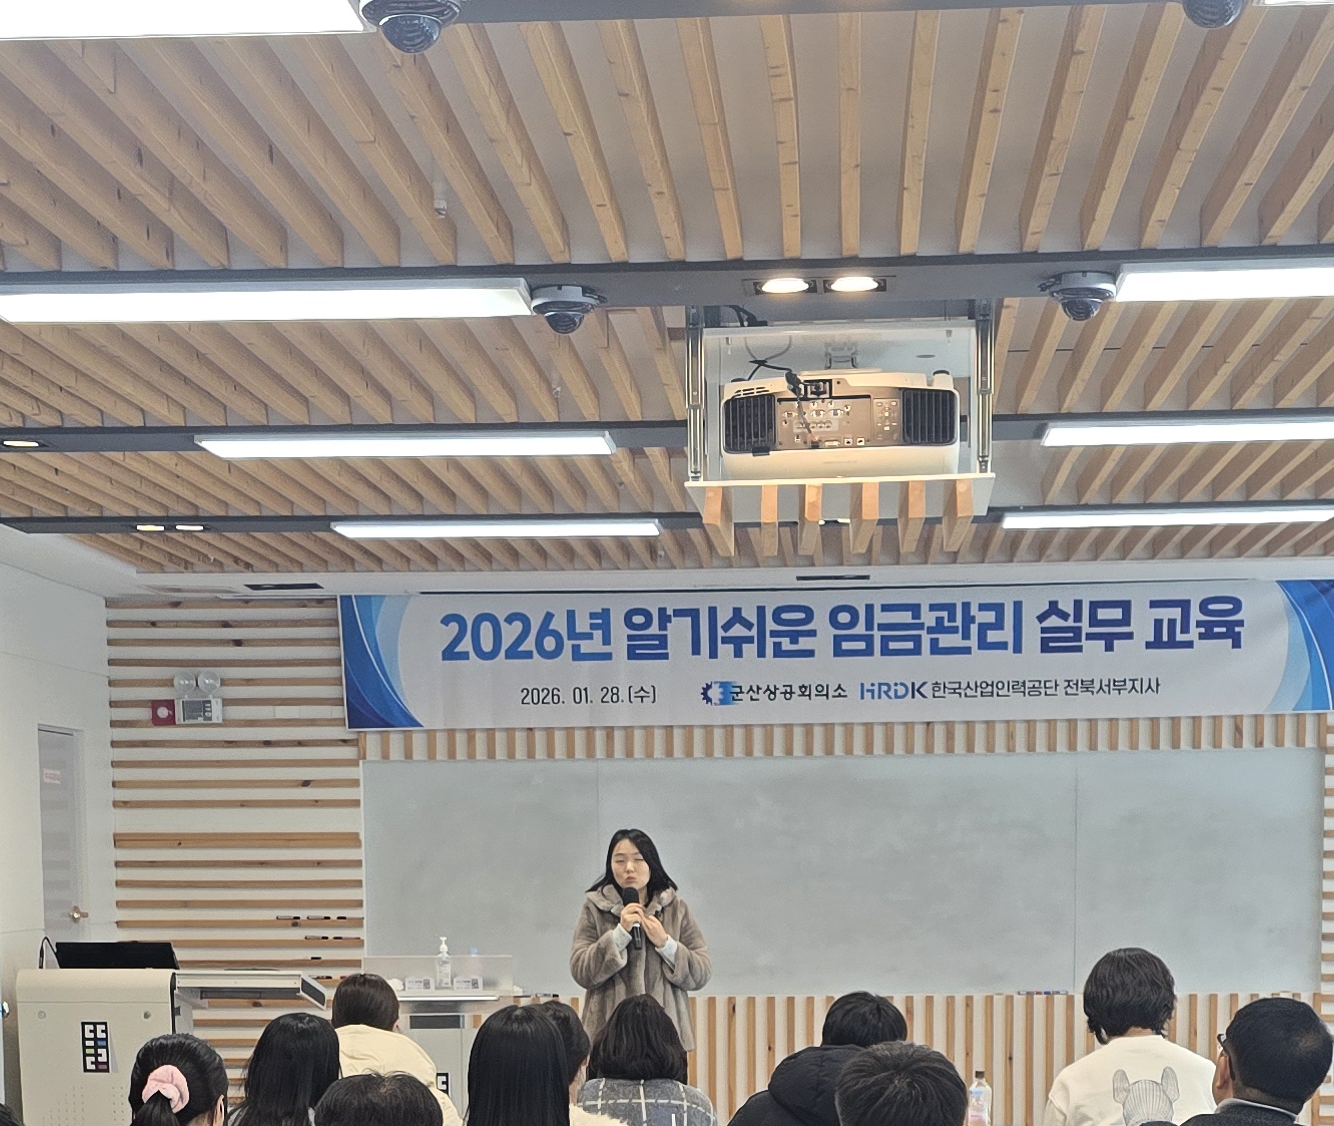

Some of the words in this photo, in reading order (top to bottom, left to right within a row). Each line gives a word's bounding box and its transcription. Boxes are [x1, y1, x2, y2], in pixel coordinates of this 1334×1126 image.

[440, 606, 613, 662] 2026년
[623, 604, 817, 661] 알기쉬운
[828, 600, 1023, 658] 임금관리
[1035, 598, 1134, 654] 실무
[1144, 595, 1244, 650] 교육
[520, 686, 565, 705] 2026.
[572, 686, 593, 704] 01.
[730, 681, 848, 701] 군산상공회의소
[860, 680, 928, 700] HRDK
[931, 680, 1059, 699] 한국산업인력공단
[1063, 677, 1161, 696] 전북서부지사
